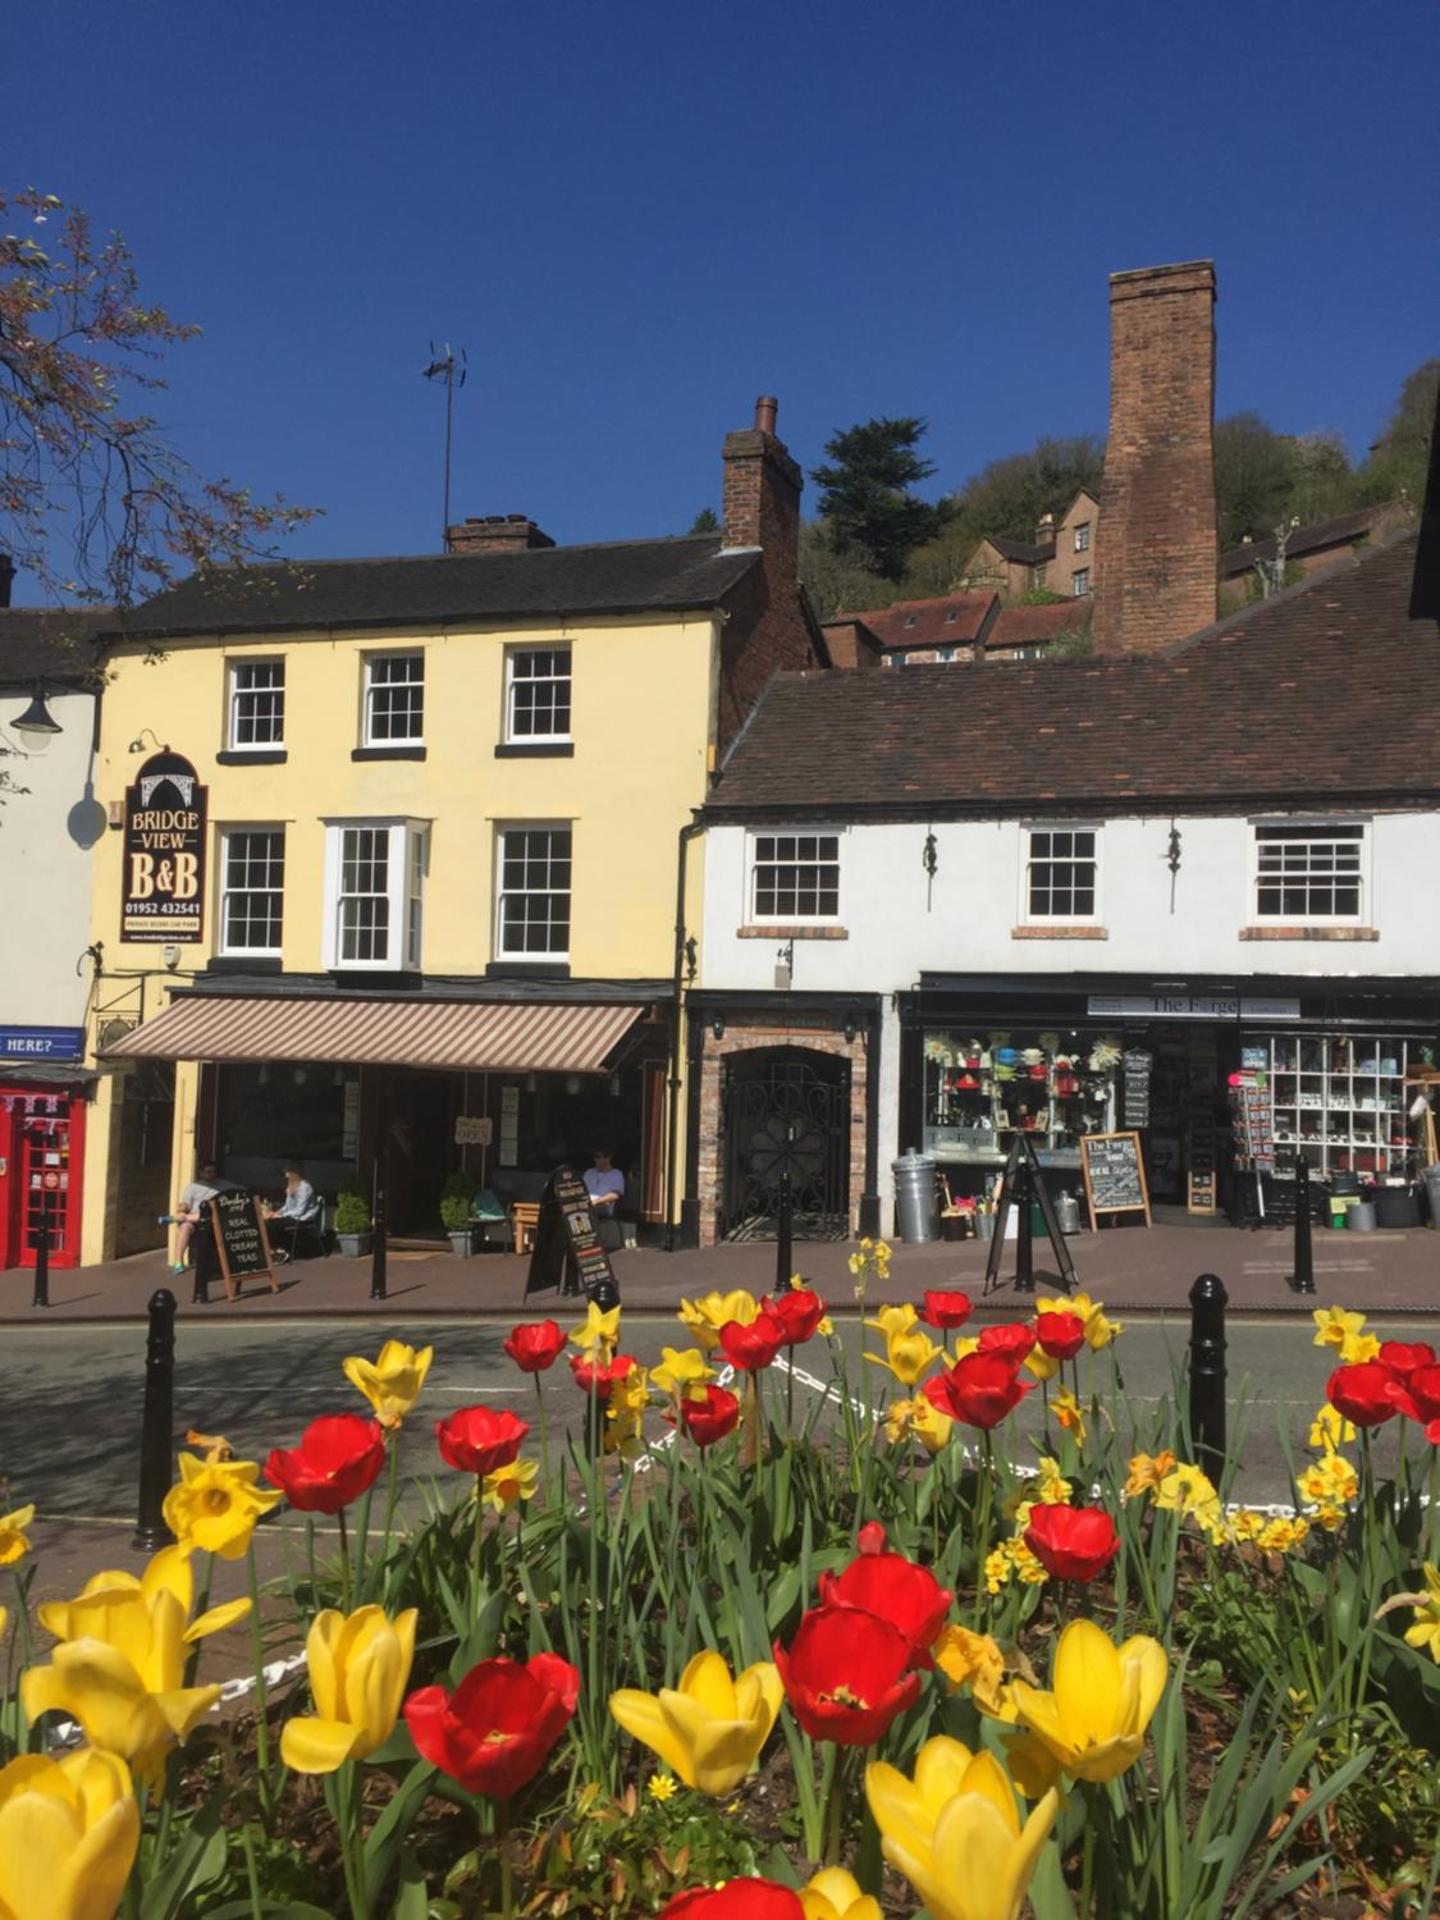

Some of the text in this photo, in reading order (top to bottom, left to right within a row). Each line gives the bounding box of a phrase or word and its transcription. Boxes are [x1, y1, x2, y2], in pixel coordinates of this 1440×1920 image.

[132, 810, 199, 830] BRIDGE
[142, 832, 187, 849] VIEW
[130, 852, 198, 899] B&B
[125, 903, 200, 914] 01952 432541
[1153, 997, 1183, 1012] The
[7, 1039, 53, 1052] HERE?
[229, 1218, 249, 1227] REAL
[225, 1229, 258, 1240] CLOTTED
[231, 1241, 258, 1251] CREAM
[237, 1253, 258, 1262] TEAS
